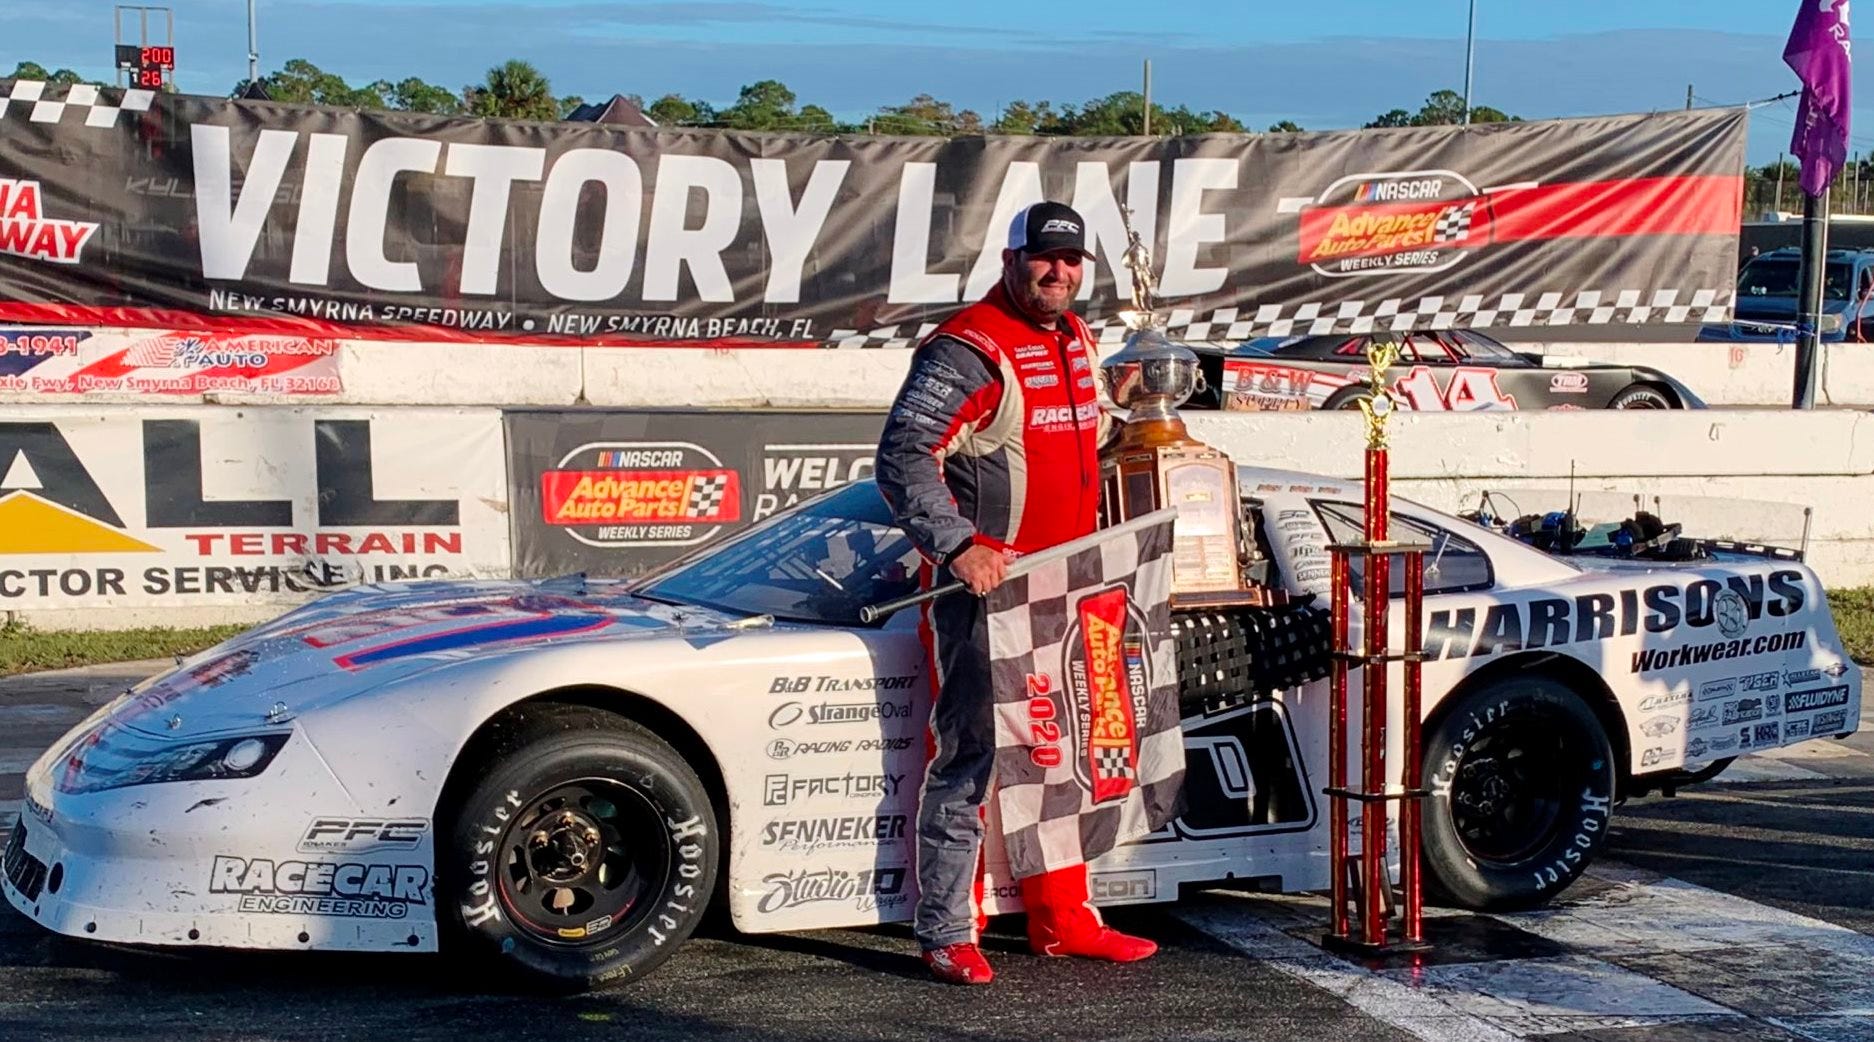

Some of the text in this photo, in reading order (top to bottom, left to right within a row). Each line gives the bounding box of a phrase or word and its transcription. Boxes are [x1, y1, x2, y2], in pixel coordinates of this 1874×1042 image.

[141, 47, 172, 64] 200
[141, 71, 161, 87] 26
[1374, 179, 1443, 201] NASCAR
[191, 124, 1239, 303] VICTORY LANE
[1325, 211, 1437, 238] Advance
[1309, 237, 1362, 259] Auto
[1340, 251, 1439, 272] WEEKLY SERIES
[208, 289, 814, 340] NEW SMYRNA SPEEDWAY NEW SMYRNA BEACH, FL
[205, 338, 334, 355] AMERICAN
[80, 376, 121, 389] New
[126, 376, 191, 393] Smyrna
[286, 377, 340, 392] 32168
[1233, 366, 1317, 397] B & W
[1396, 366, 1519, 411] 14
[618, 450, 684, 468] NASCAR
[0, 419, 460, 529] ALL
[569, 475, 684, 500] Advance
[556, 498, 680, 519] Auto Parts
[185, 532, 463, 556] TERRAIN
[597, 525, 692, 540] WEEKLY SERIES
[0, 567, 128, 597] CTOR
[143, 563, 349, 595] SERVICE
[1425, 570, 1805, 662] HARRISONS
[1087, 613, 1105, 675] Auto
[1630, 628, 1806, 674] Workwear.com
[768, 676, 812, 694] B&B
[1071, 660, 1092, 716] WEEKLY
[1127, 663, 1146, 728] NASCAR
[1798, 688, 1847, 709] FLUIDYNE
[1026, 673, 1064, 769] 2020
[793, 737, 914, 755] RACING RADIOS
[792, 771, 906, 801] FACTORY
[306, 820, 426, 842] PFC
[762, 814, 908, 846] SENNEKER
[461, 789, 523, 928] Hoosier
[209, 855, 429, 906] RACECAR
[648, 814, 708, 947] Hoosier
[242, 897, 406, 917] ENGINEERING
